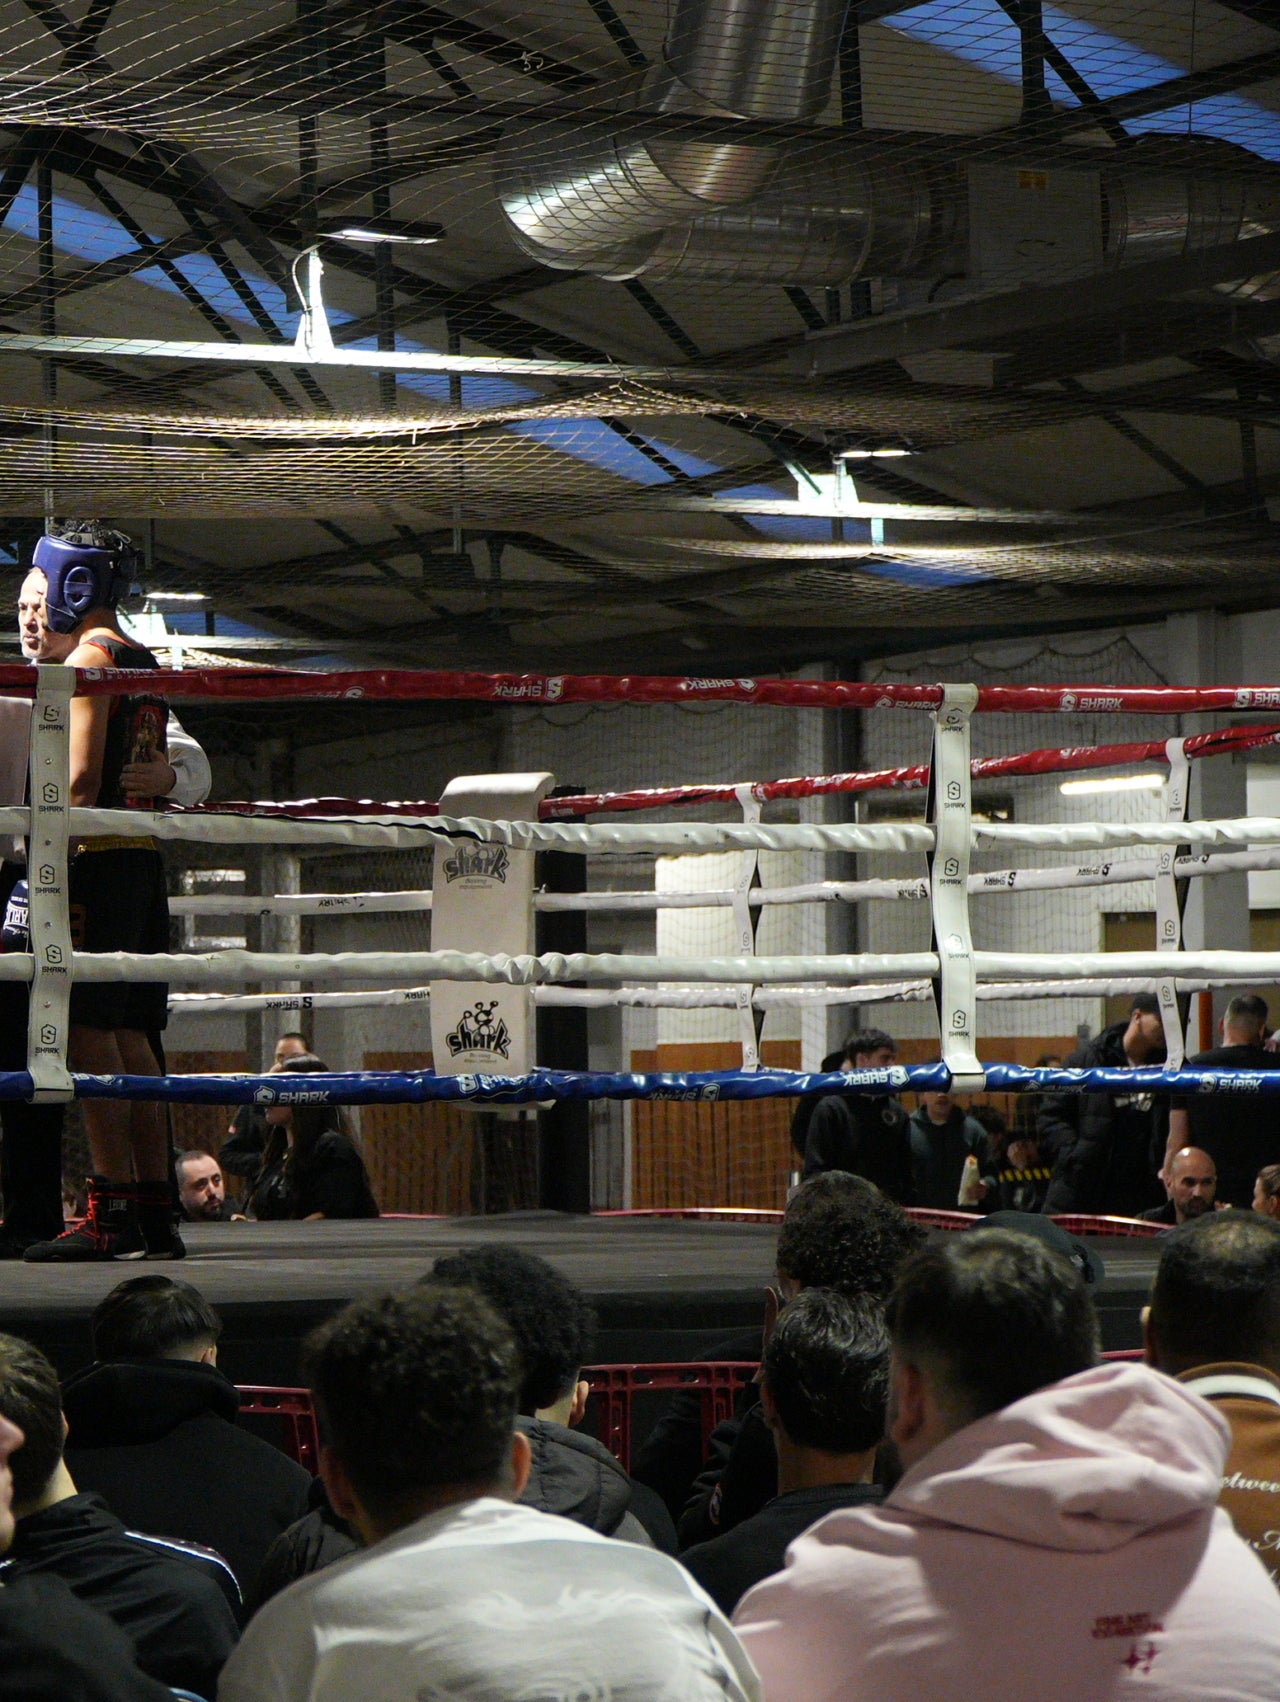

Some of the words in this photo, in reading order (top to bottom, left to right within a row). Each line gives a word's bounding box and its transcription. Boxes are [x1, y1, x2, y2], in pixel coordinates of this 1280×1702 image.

[687, 678, 736, 690] SHARK
[492, 685, 542, 697] SHARK
[1079, 697, 1123, 709] SHARK
[1255, 693, 1280, 704] SHA
[404, 991, 431, 999] HARK
[843, 1074, 889, 1087] SHARK
[1219, 1078, 1262, 1091] SHARK
[278, 1090, 330, 1104] SHARK
